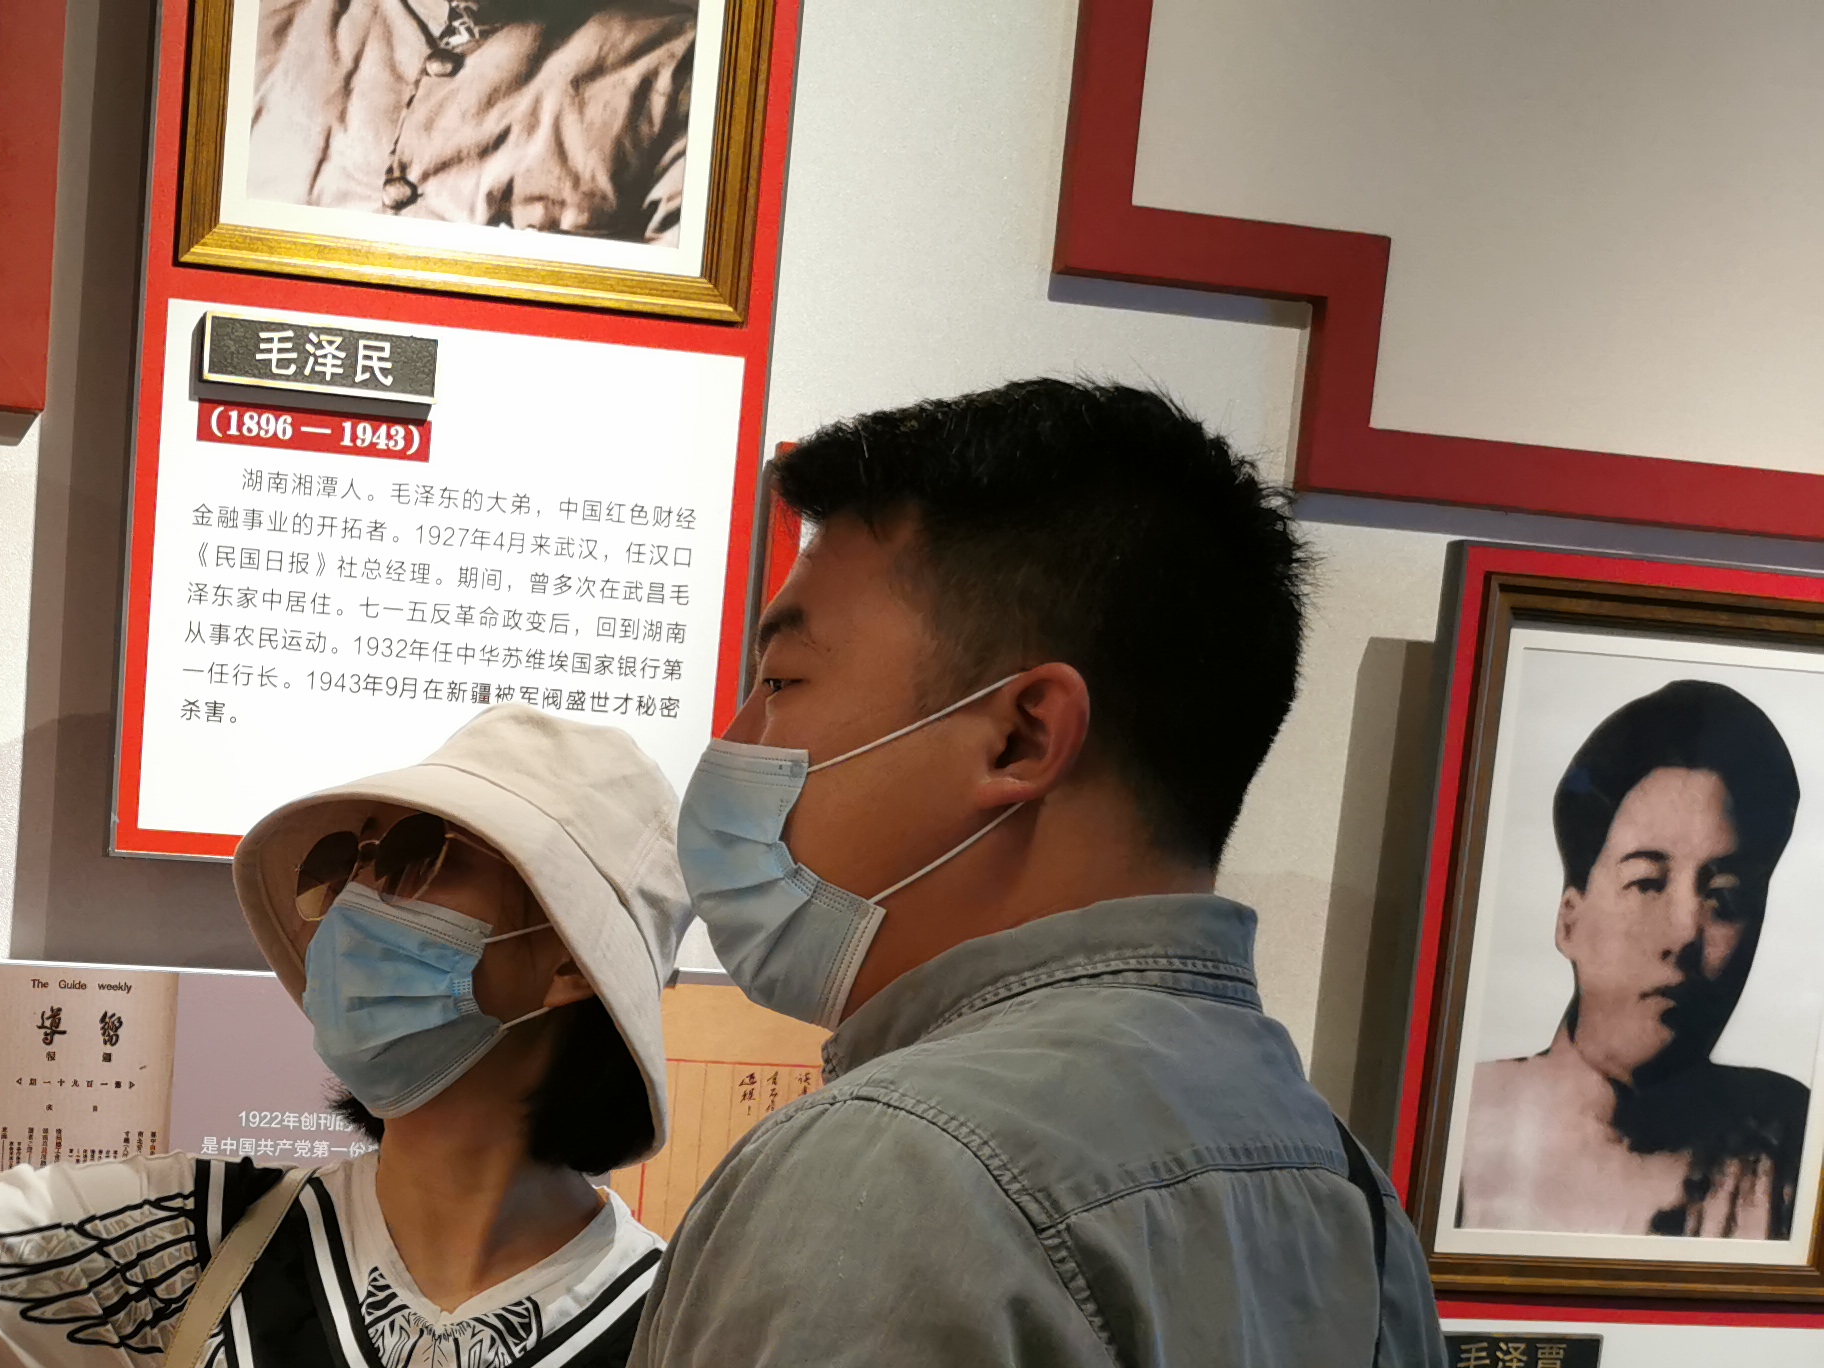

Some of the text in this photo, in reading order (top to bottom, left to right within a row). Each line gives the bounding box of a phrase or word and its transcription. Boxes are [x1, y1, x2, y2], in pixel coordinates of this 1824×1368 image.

[255, 328, 395, 386] 毛泽民
[210, 406, 294, 441] (1896
[338, 417, 422, 454] 1943)
[241, 468, 698, 531] 湖南湘潭人。毛泽东的大弟，中国红色财经
[191, 504, 694, 567] 金融事业的开拓者。1927年4月来武汉，任汉口
[194, 545, 691, 608] 《民国日报》社总经理。期间，曾多次在武昌毛
[186, 582, 688, 645] 泽东家中居住。七一五反革命政变后，回到湖南
[184, 620, 685, 682] 从事农民运动。1932年任中华苏维埃国家银行第
[180, 698, 240, 726] 杀害。
[30, 979, 50, 989] The
[97, 981, 133, 994] weekly
